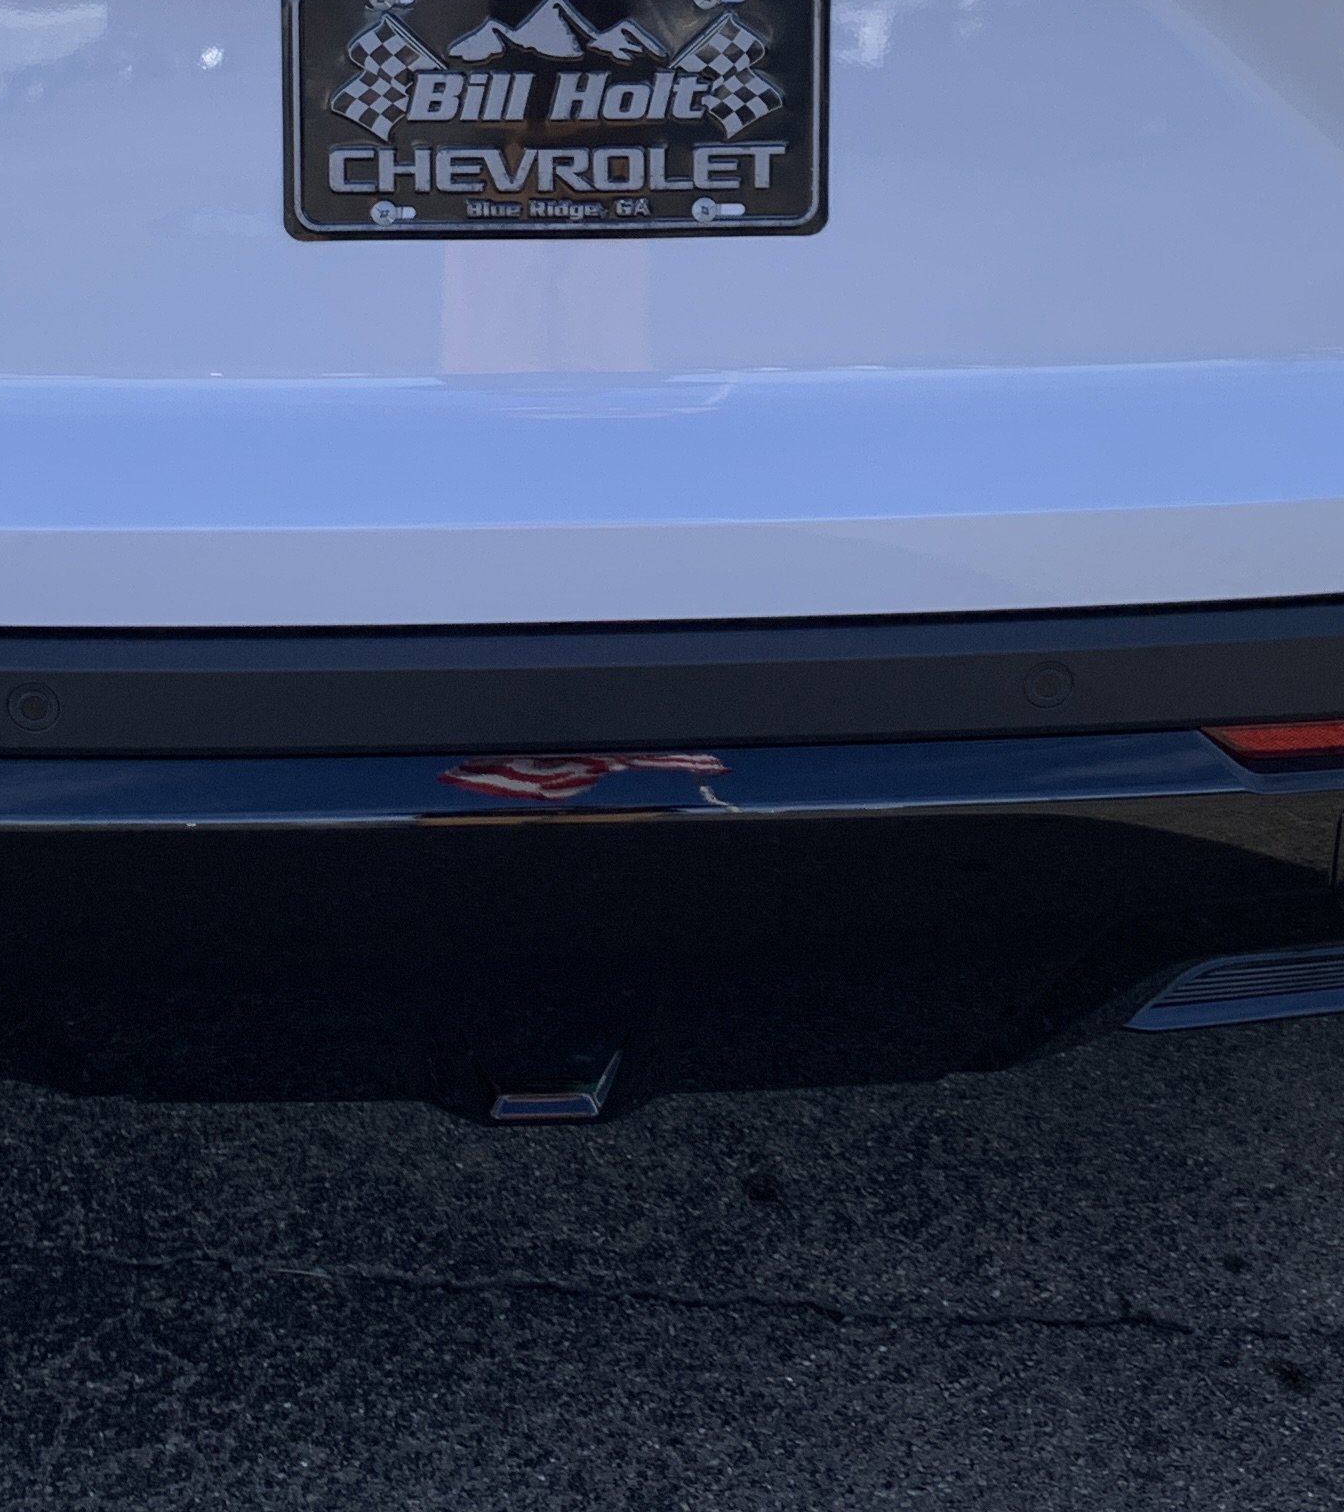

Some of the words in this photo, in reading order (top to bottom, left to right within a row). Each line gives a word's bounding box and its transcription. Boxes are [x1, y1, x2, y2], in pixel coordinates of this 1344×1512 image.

[406, 70, 534, 122] Bill
[546, 70, 712, 122] Holt
[328, 144, 787, 194] CHEVROLET
[466, 198, 521, 219] Blue
[530, 198, 608, 222] Ridge,
[616, 198, 650, 218] GA
